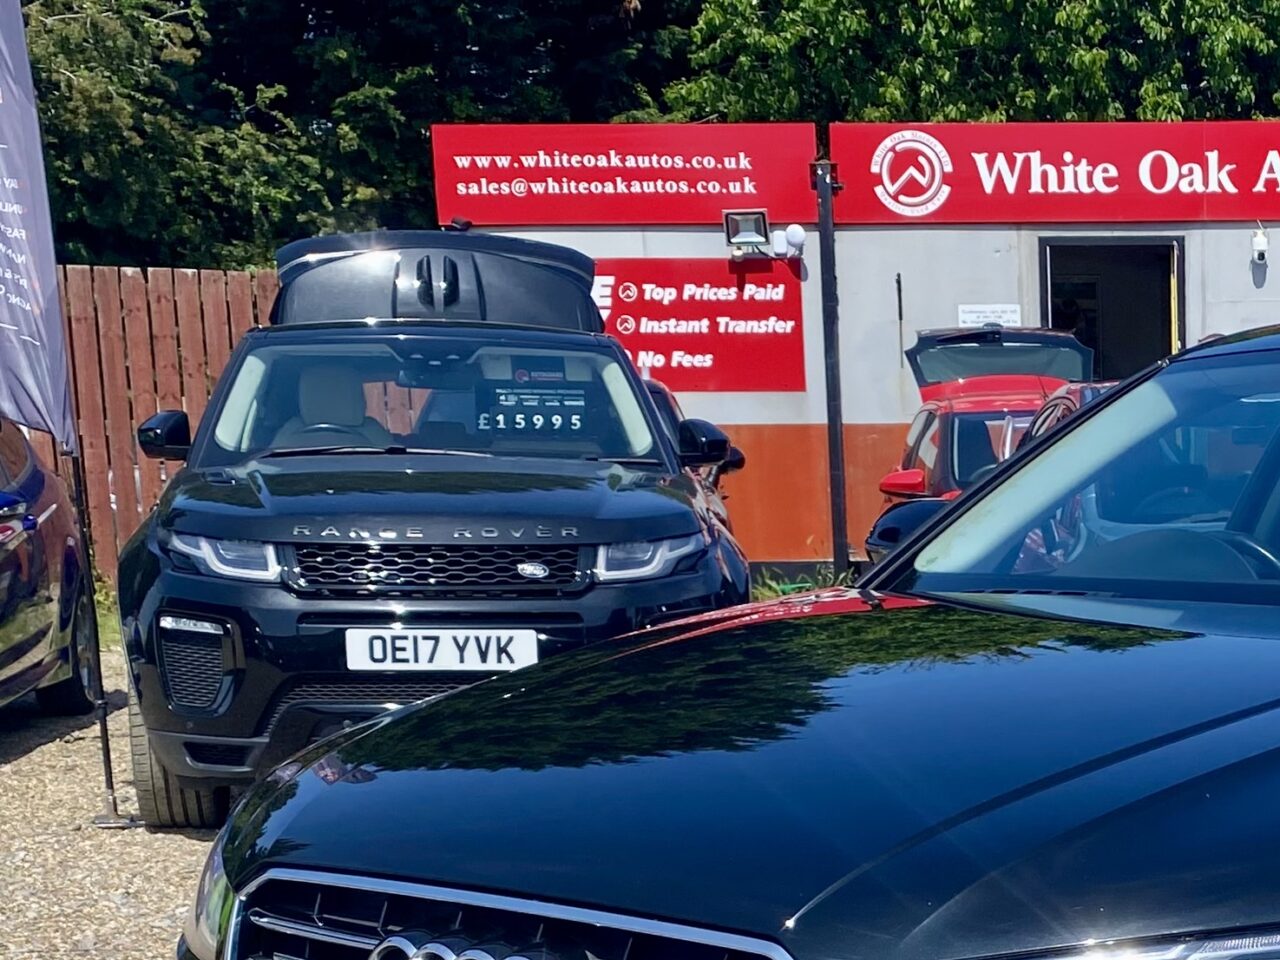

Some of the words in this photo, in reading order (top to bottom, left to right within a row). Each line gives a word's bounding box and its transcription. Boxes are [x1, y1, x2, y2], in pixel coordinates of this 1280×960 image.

[453, 149, 753, 170] www.whiteoakautos.co.uk
[970, 150, 1119, 195] White
[1138, 149, 1239, 195] Oak
[456, 176, 757, 197] sales@whiteoakautos.co.uk
[641, 283, 678, 305] Top
[682, 283, 739, 301] Prices
[742, 283, 785, 301] Paid
[639, 316, 710, 334] Instant
[716, 316, 796, 334] Transfer
[637, 350, 666, 368] No
[670, 350, 714, 368] Fees
[478, 413, 582, 430] £15995
[292, 525, 424, 538] RANGE
[453, 525, 579, 538] ROVER
[369, 635, 440, 664] OE17
[452, 636, 515, 664] YVK
